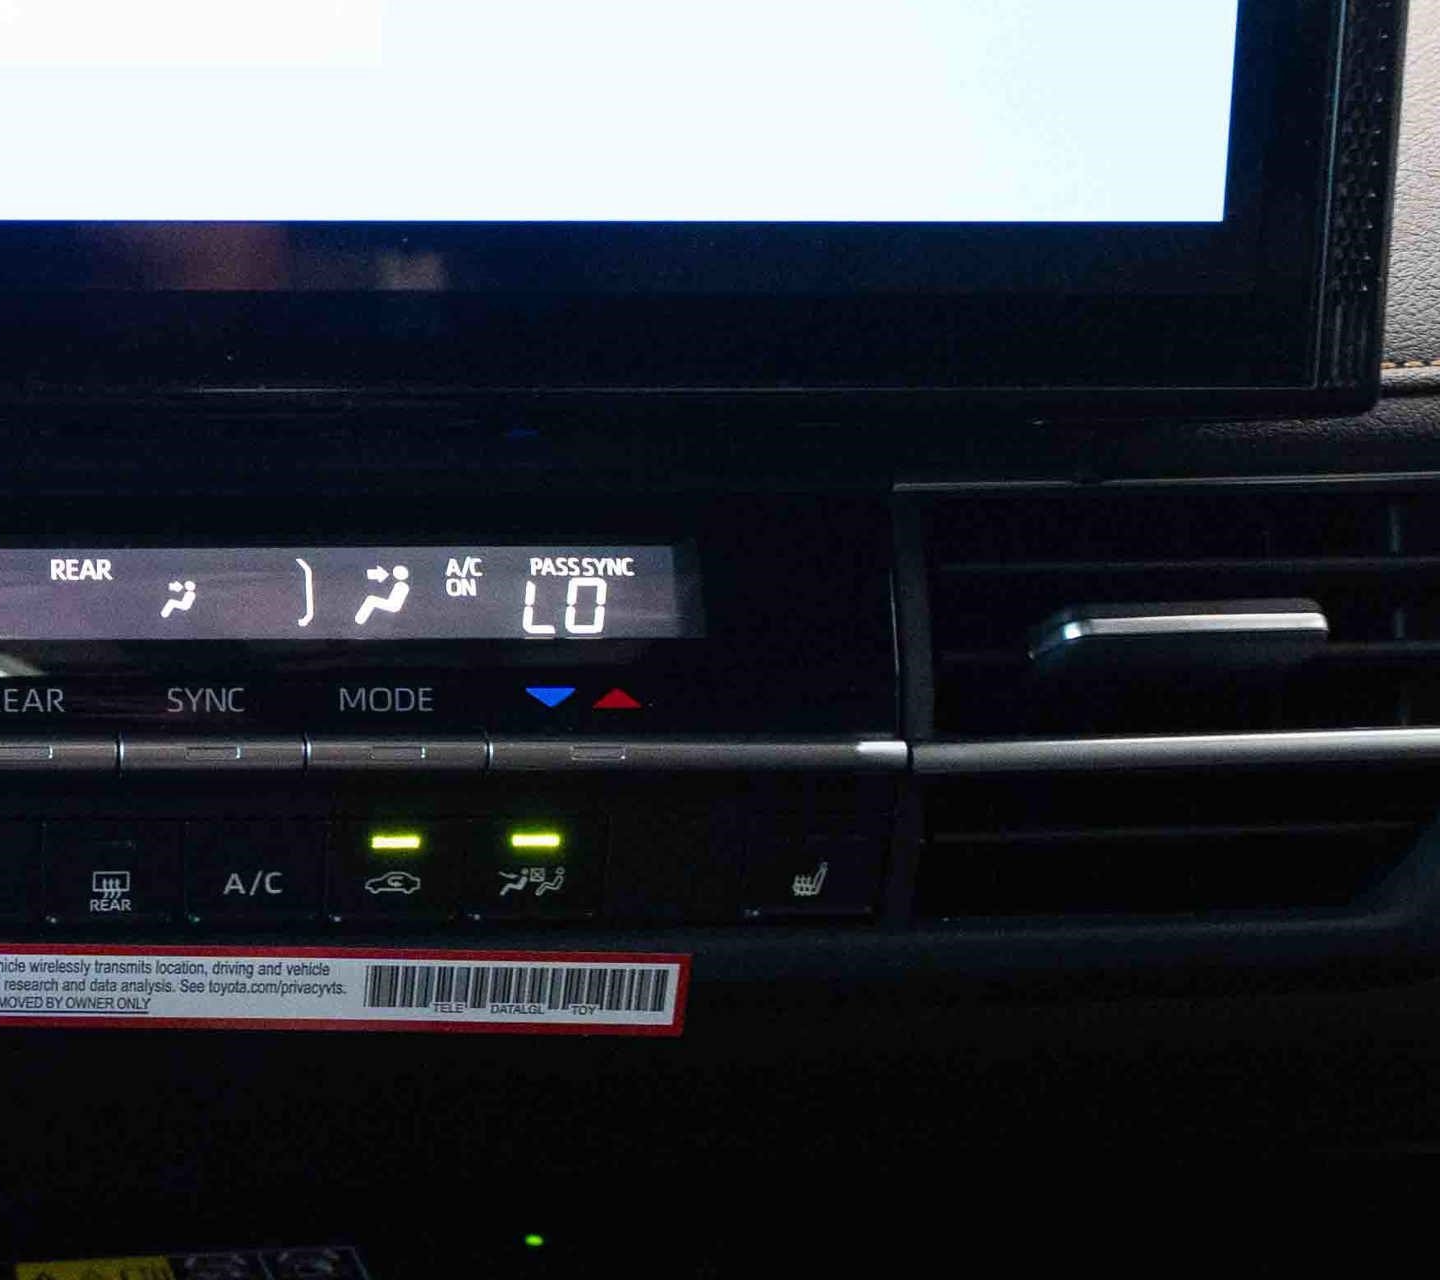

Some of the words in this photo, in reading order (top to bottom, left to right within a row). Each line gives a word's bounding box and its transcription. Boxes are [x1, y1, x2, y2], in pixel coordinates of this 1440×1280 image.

[50, 558, 113, 581] REAR
[444, 556, 483, 577] A/C
[529, 557, 579, 577] PASS
[581, 557, 635, 577] SYNC
[445, 577, 477, 597] ON
[522, 578, 608, 634] LO
[167, 687, 245, 713] SYNC
[339, 687, 433, 712] MODE
[223, 870, 283, 896] A/C
[89, 898, 132, 912] REAR
[30, 958, 90, 976] wirelessly
[94, 959, 152, 974] transmits
[155, 960, 208, 976] location,
[212, 961, 253, 978] driving
[258, 962, 282, 976] and
[286, 962, 330, 976] vehicle
[4, 978, 58, 992] research
[62, 978, 85, 992] and
[90, 978, 116, 992] data
[121, 979, 176, 995] analysis.
[180, 978, 205, 993] See
[208, 980, 347, 998] toyota.com/privacyvts.
[46, 997, 63, 1009] BY
[65, 997, 114, 1009] OWNER
[117, 998, 151, 1010] ONLY
[432, 1003, 464, 1014] TELE
[570, 1004, 598, 1016] TOY
